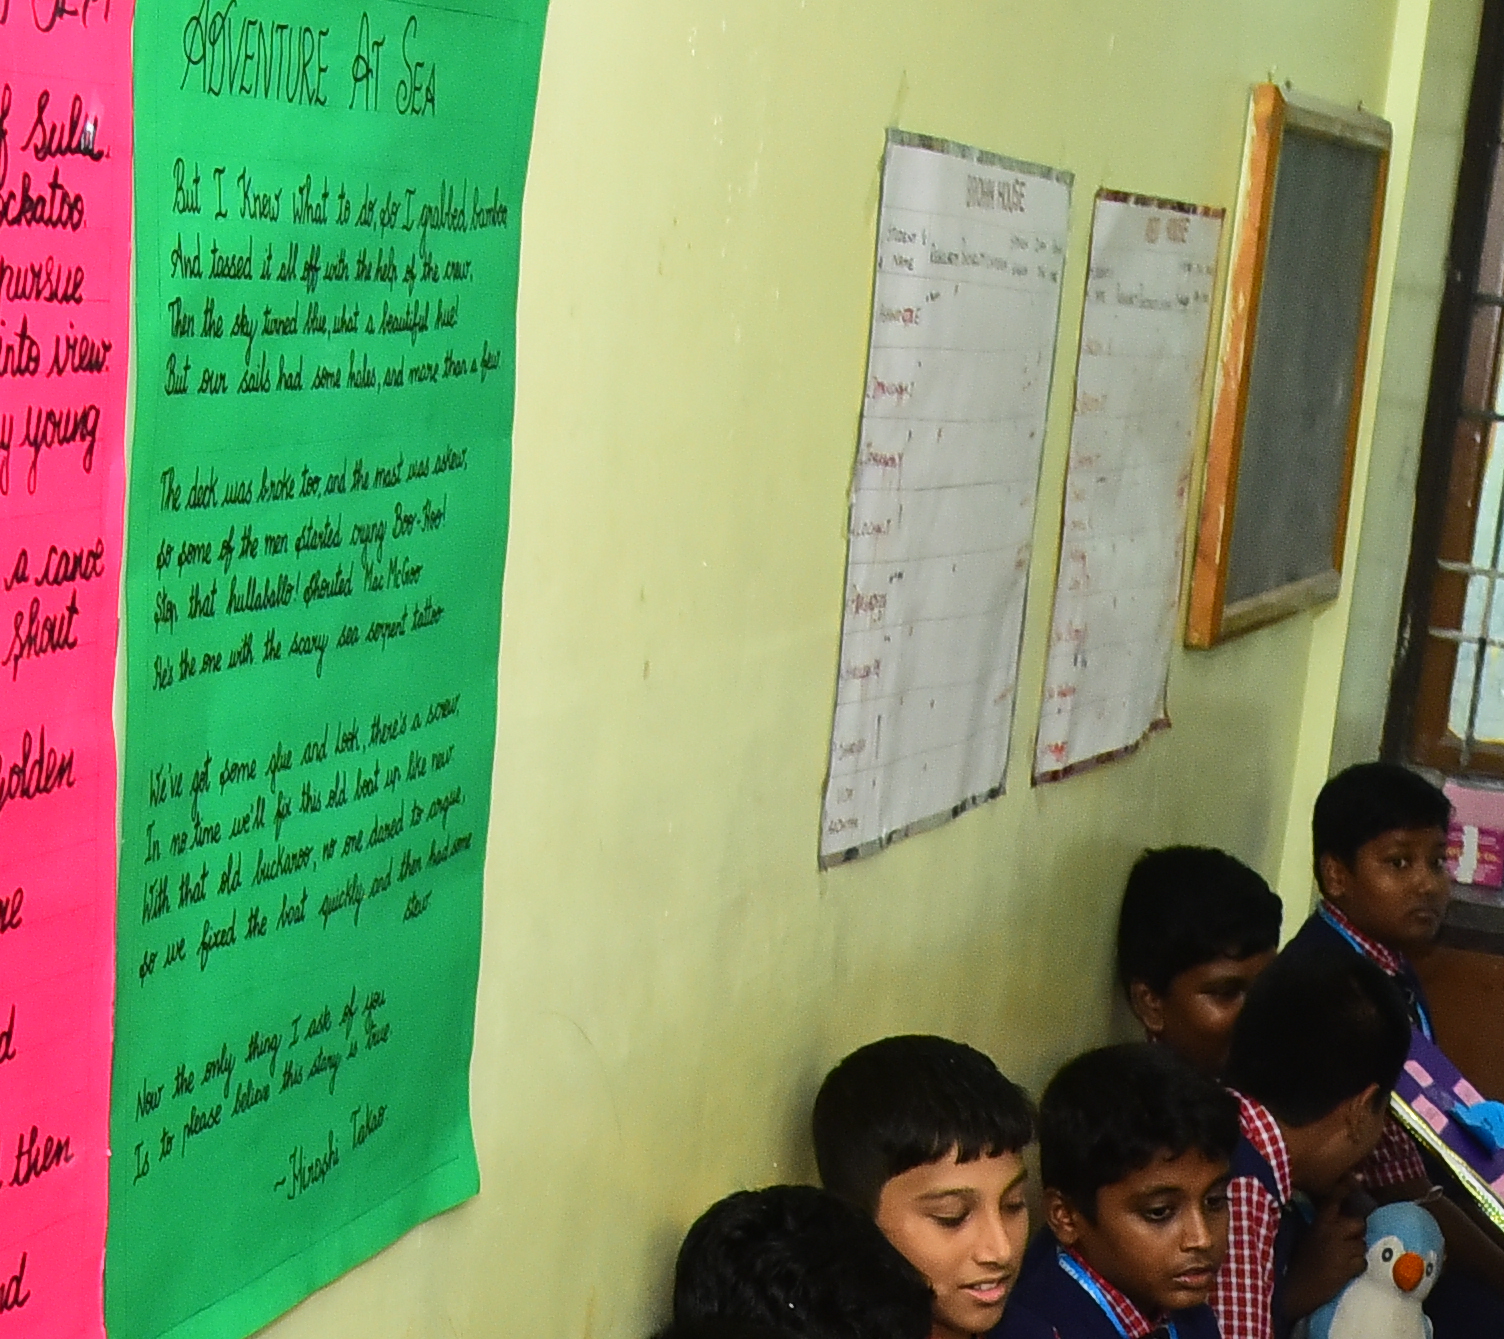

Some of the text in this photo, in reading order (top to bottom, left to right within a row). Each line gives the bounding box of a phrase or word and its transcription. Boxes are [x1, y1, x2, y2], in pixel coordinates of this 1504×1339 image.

[172, 157, 201, 214] But
[212, 166, 228, 220] I
[336, 182, 351, 225] to
[401, 187, 416, 232] I
[417, 178, 469, 259] grabbed
[164, 350, 342, 396] But our sails had some
[172, 1063, 195, 1101] the
[200, 1042, 236, 1100] only
[245, 1030, 283, 1078] thing
[289, 1015, 302, 1047] I
[304, 1004, 333, 1041] ask
[339, 984, 359, 1041] of
[362, 989, 387, 1031] you
